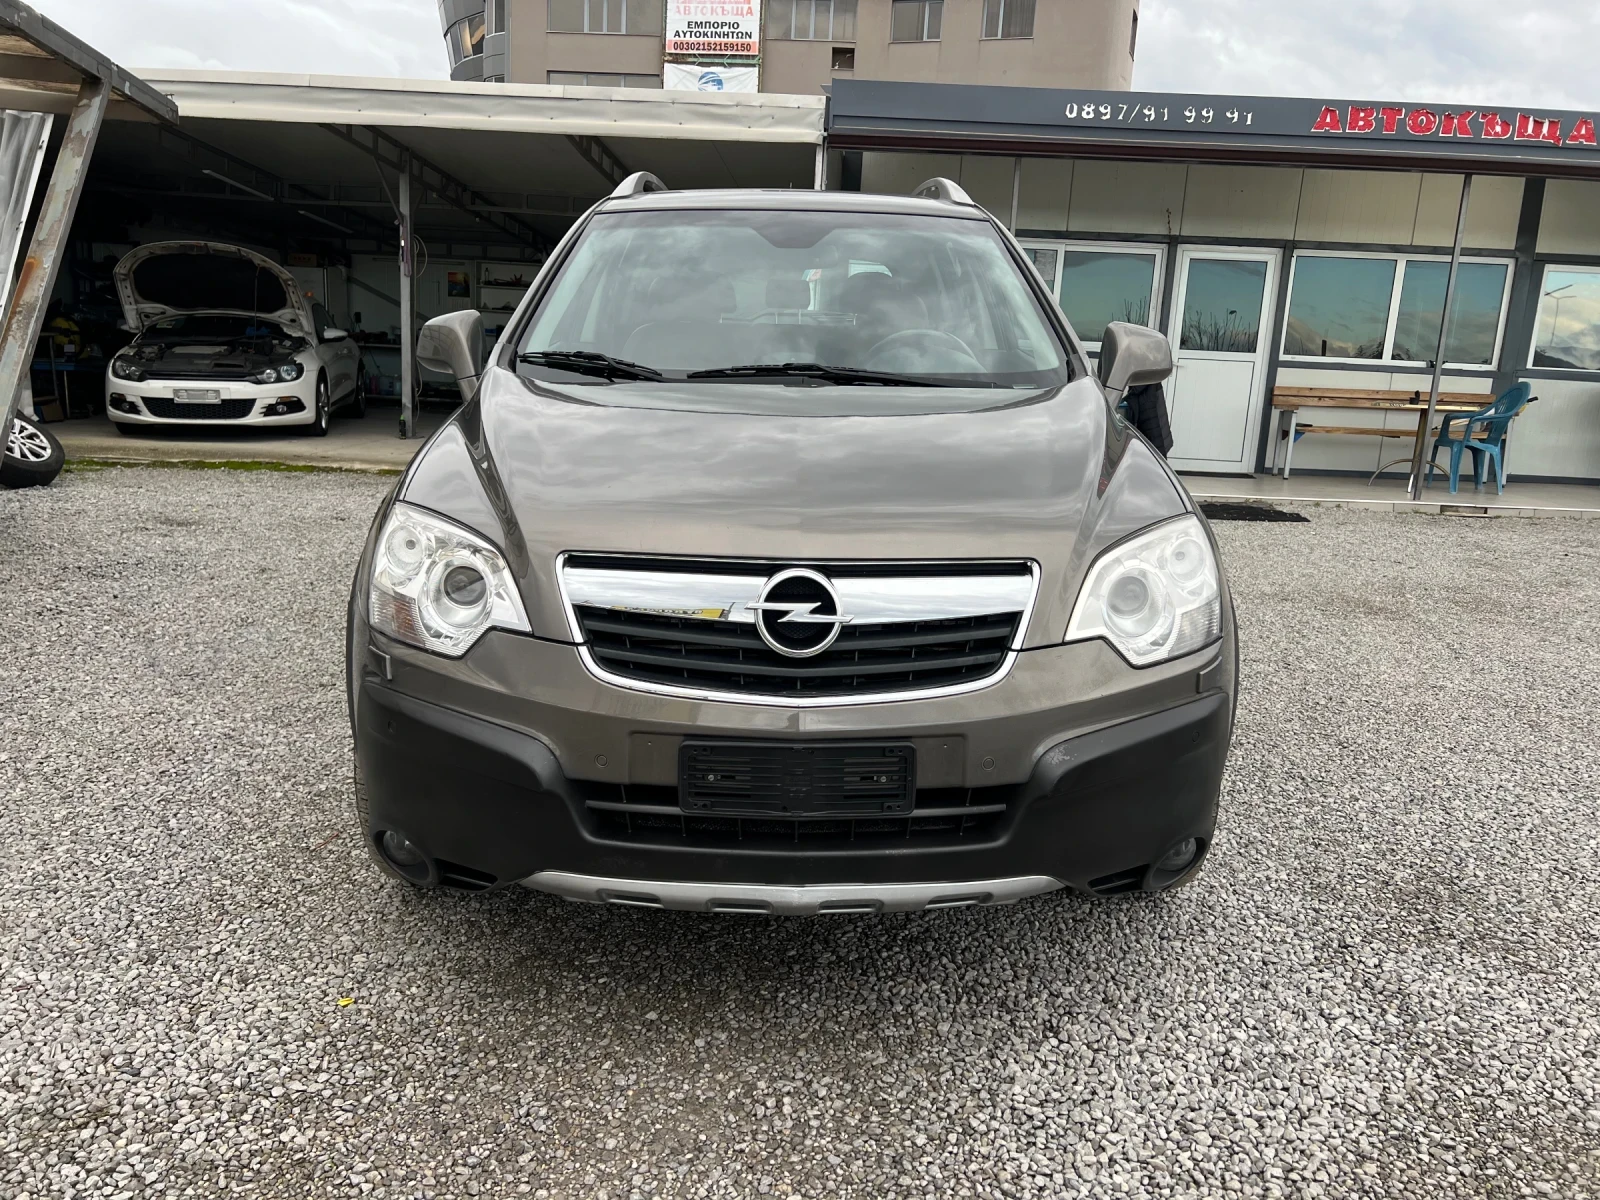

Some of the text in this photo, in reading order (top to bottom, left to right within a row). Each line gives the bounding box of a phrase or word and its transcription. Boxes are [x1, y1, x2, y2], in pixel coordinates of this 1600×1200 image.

[674, 5, 754, 18] АВТОКЪЩА
[687, 21, 740, 30] ΕΜΠΟΡΙΟ
[673, 30, 752, 40] ΑΥΤΟΚΙΝΗΤΩΝ
[673, 41, 751, 52] 00302152159150
[1065, 102, 1253, 125] 0897/91 99 91
[1311, 105, 1597, 146] АВТОКЪЩА
